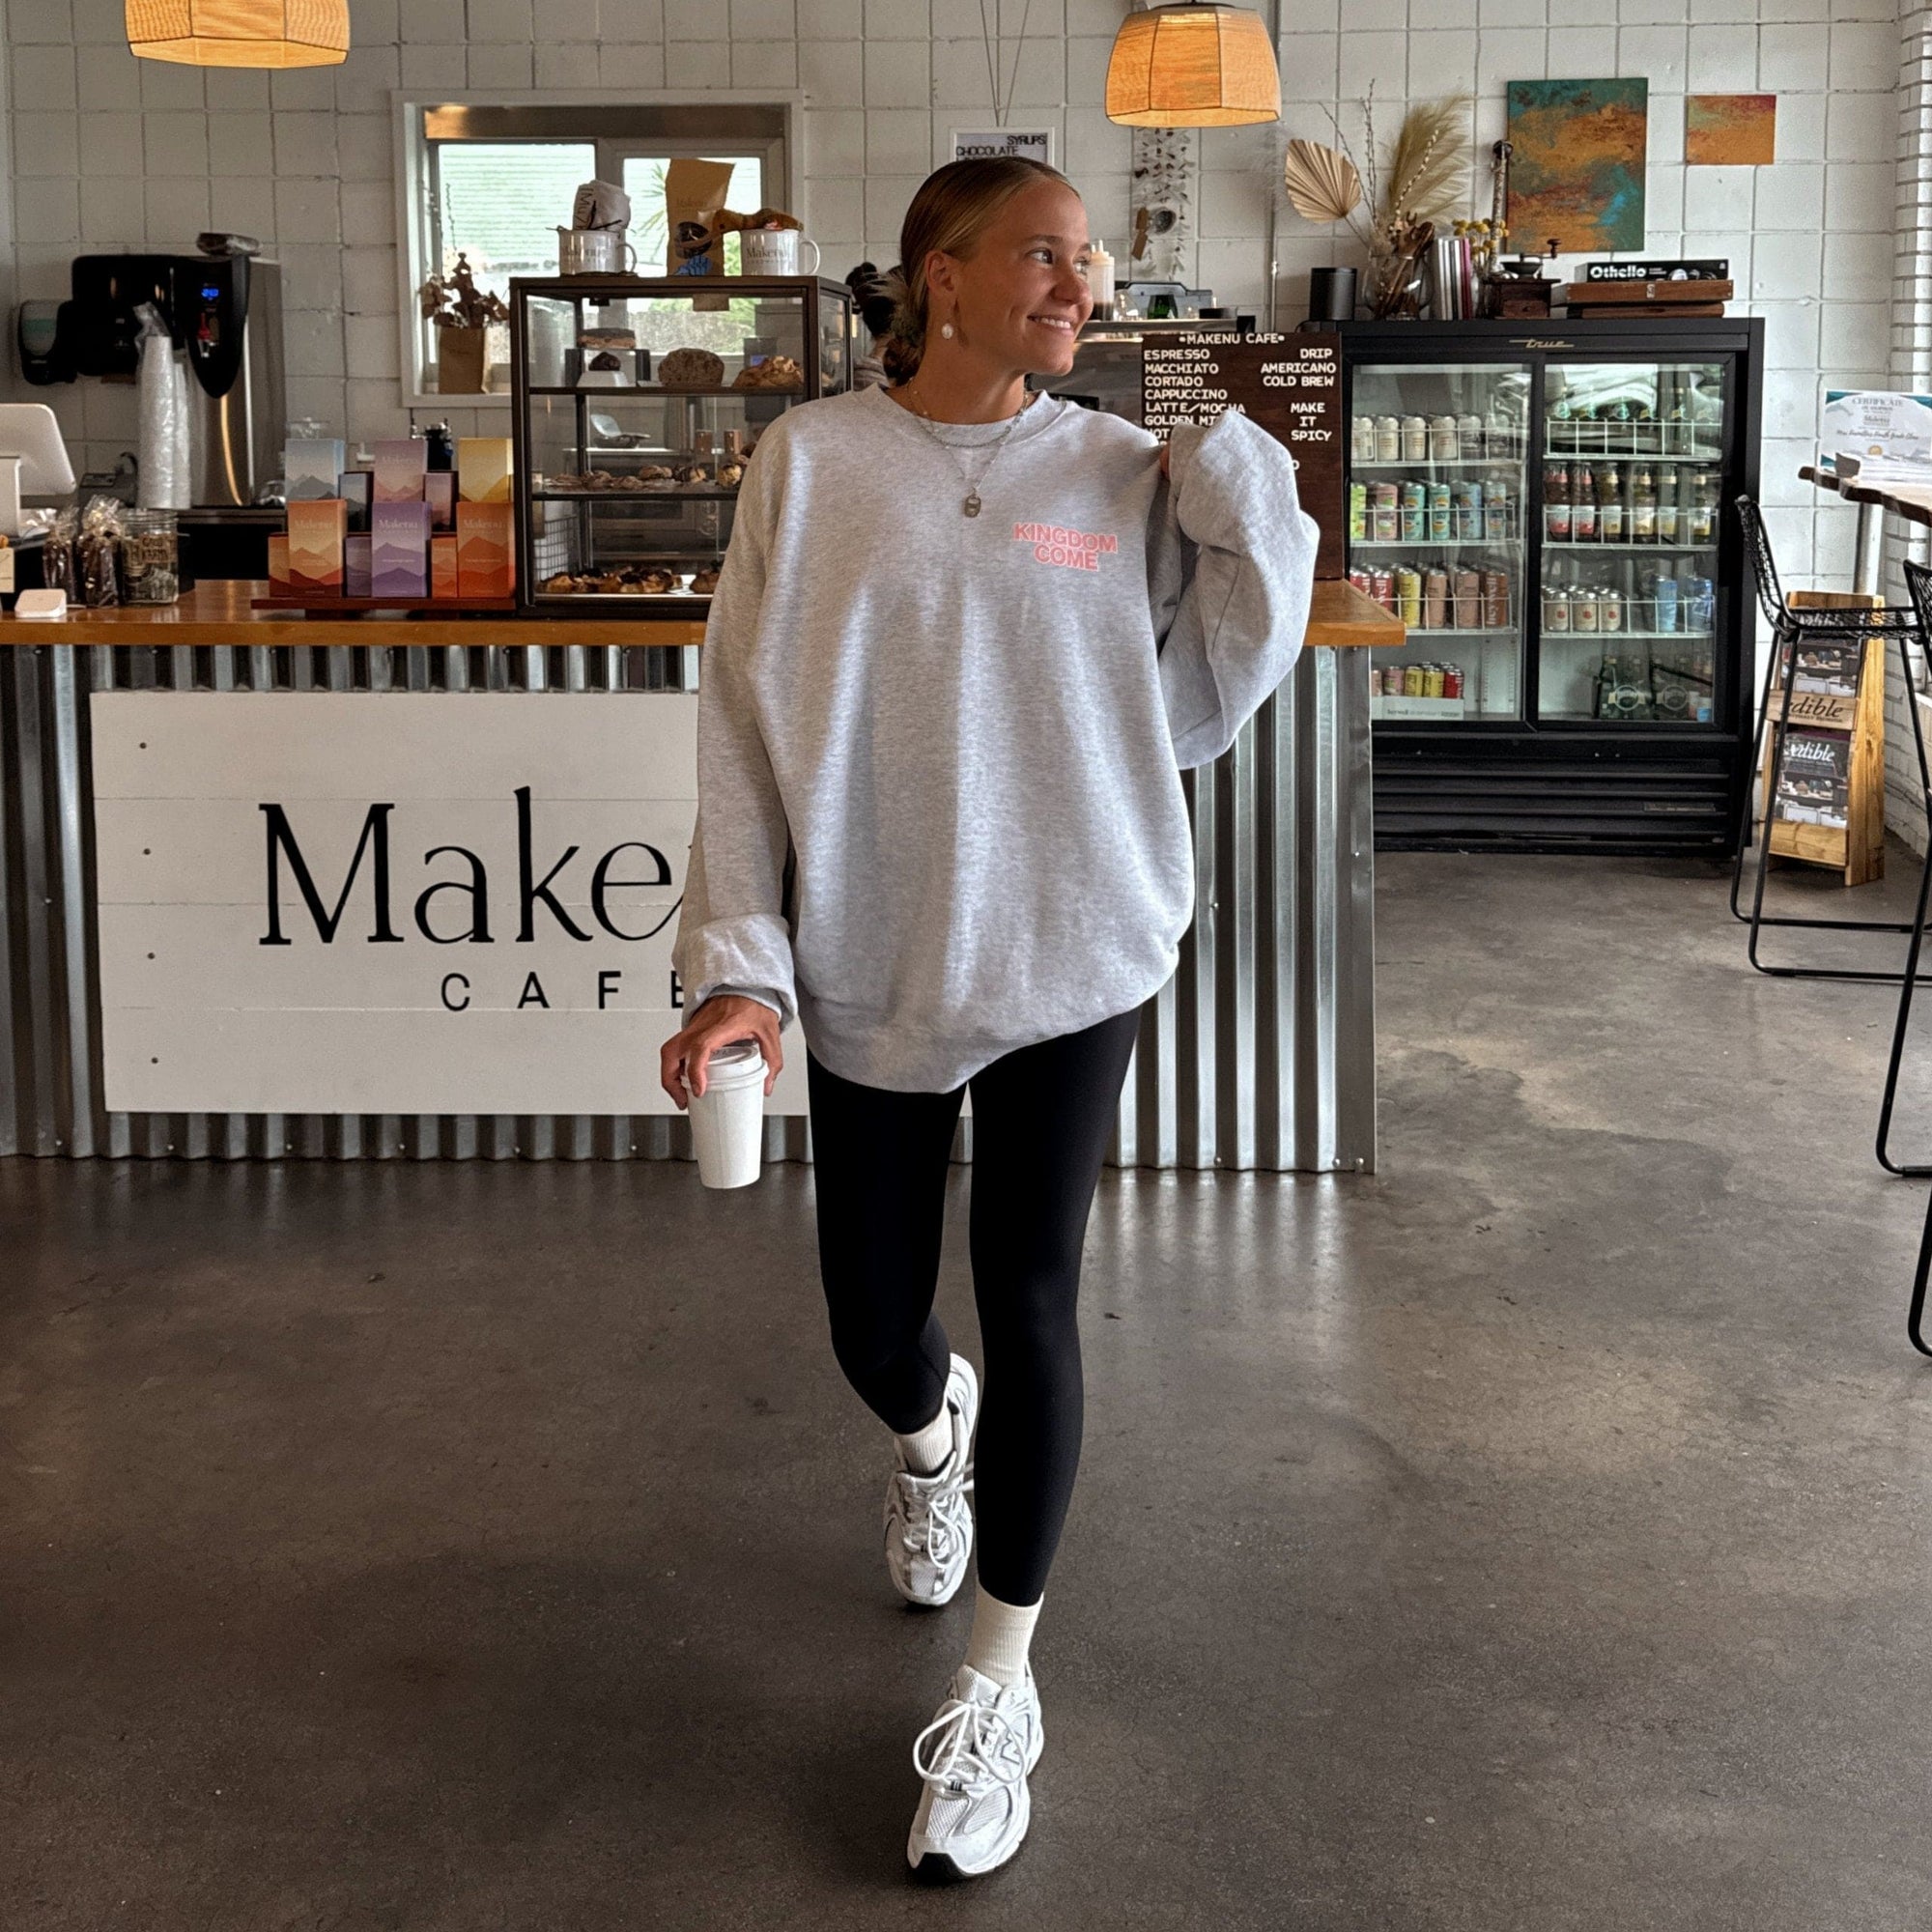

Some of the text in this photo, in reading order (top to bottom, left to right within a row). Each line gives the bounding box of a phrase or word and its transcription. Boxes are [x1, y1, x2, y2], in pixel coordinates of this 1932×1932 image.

[1007, 135, 1046, 146] SYRUPS
[956, 146, 1019, 156] CHOCOLATE
[1589, 265, 1647, 279] Othello
[1186, 333, 1279, 345] MAKENU CAFE
[1143, 349, 1210, 360] ESPRESSO
[1299, 348, 1333, 359] DRIP
[1145, 362, 1219, 375] MACCHIATO
[1261, 362, 1337, 374] AMERICANO
[1144, 376, 1204, 387] CORTADO
[1263, 376, 1334, 386] COLD BREW
[1144, 388, 1228, 400] CAPPUCCINO
[1290, 402, 1325, 413] MAKE
[1299, 415, 1317, 427] IT
[1151, 428, 1171, 440] OT
[1291, 430, 1332, 441] SPICY
[1011, 522, 1118, 554] KINGDOM
[1033, 542, 1099, 572] COME
[1789, 696, 1844, 718] dible
[258, 784, 691, 946] Make
